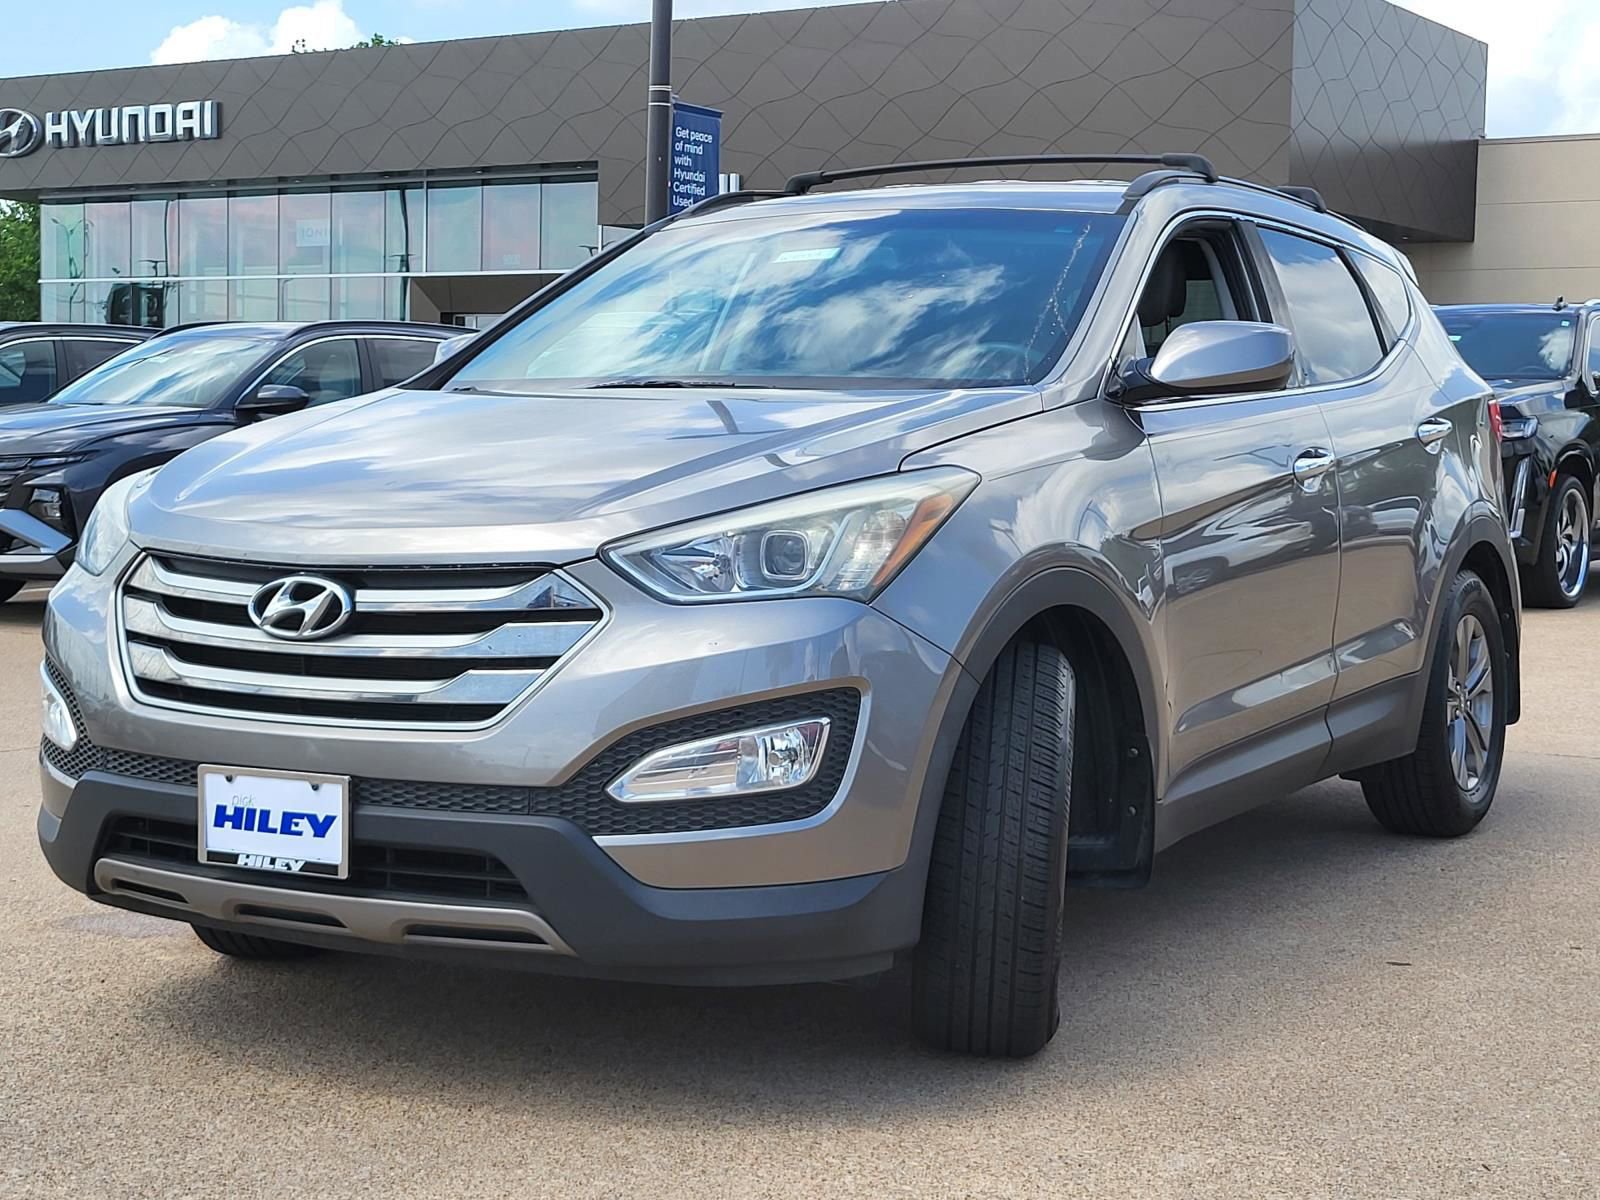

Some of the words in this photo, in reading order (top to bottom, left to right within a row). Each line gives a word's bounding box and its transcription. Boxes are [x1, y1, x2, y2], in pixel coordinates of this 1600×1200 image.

[45, 100, 216, 147] HYUNDAI
[675, 127, 689, 139] Get
[690, 130, 713, 143] peace
[675, 141, 683, 151] of
[684, 143, 703, 155] mind
[674, 154, 692, 166] with
[673, 168, 706, 183] Hyundai
[673, 182, 706, 196] Certified
[673, 195, 693, 207] Used
[213, 804, 338, 838] HILEY
[237, 854, 307, 872] HILEY
